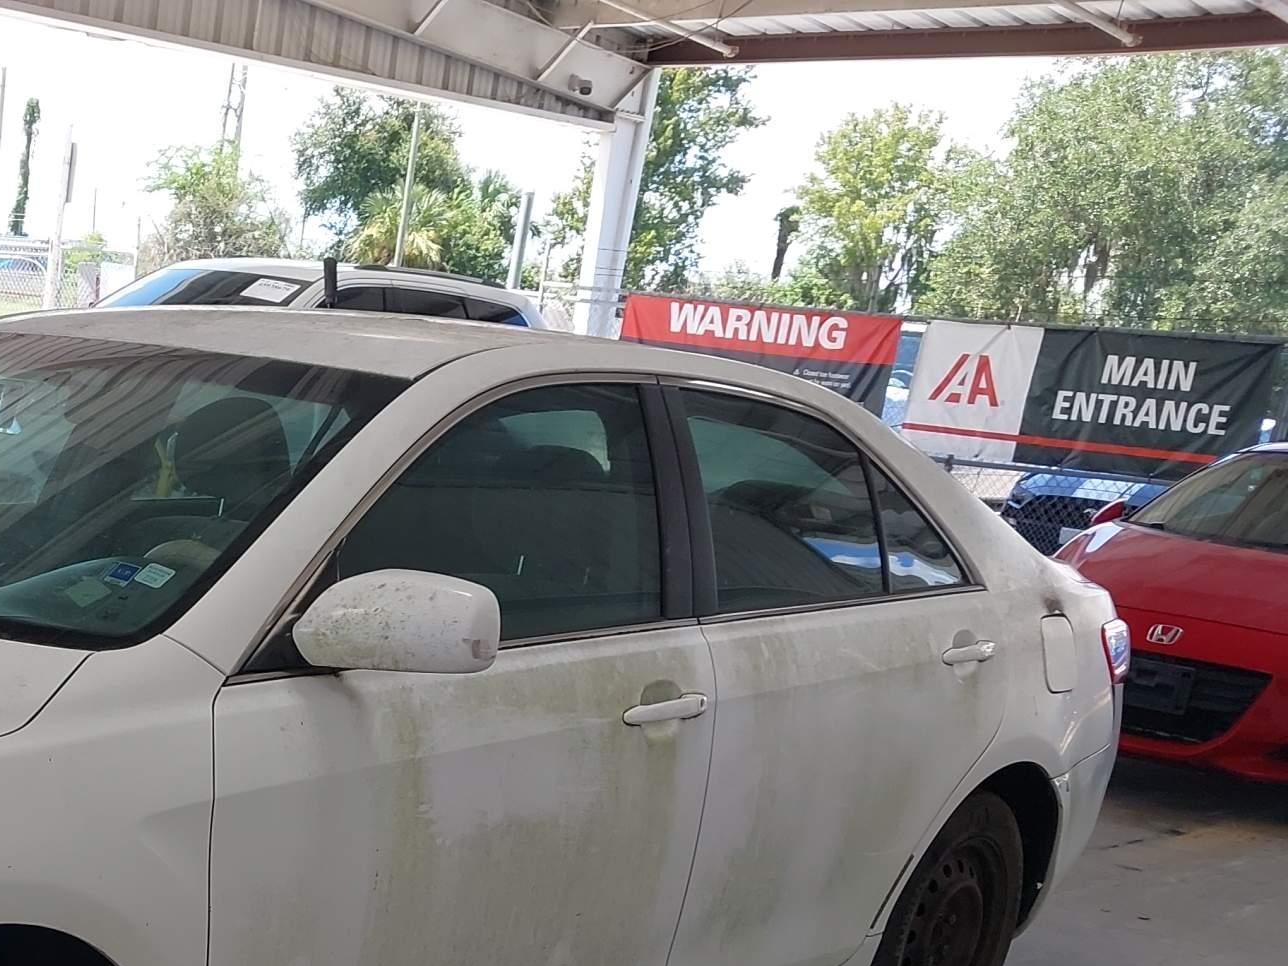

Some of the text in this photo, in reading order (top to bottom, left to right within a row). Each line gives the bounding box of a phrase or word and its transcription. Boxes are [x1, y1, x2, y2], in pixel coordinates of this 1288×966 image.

[669, 302, 848, 350] WARNING
[1100, 354, 1198, 392] MAIN
[1051, 390, 1232, 436] ENTRANCE
